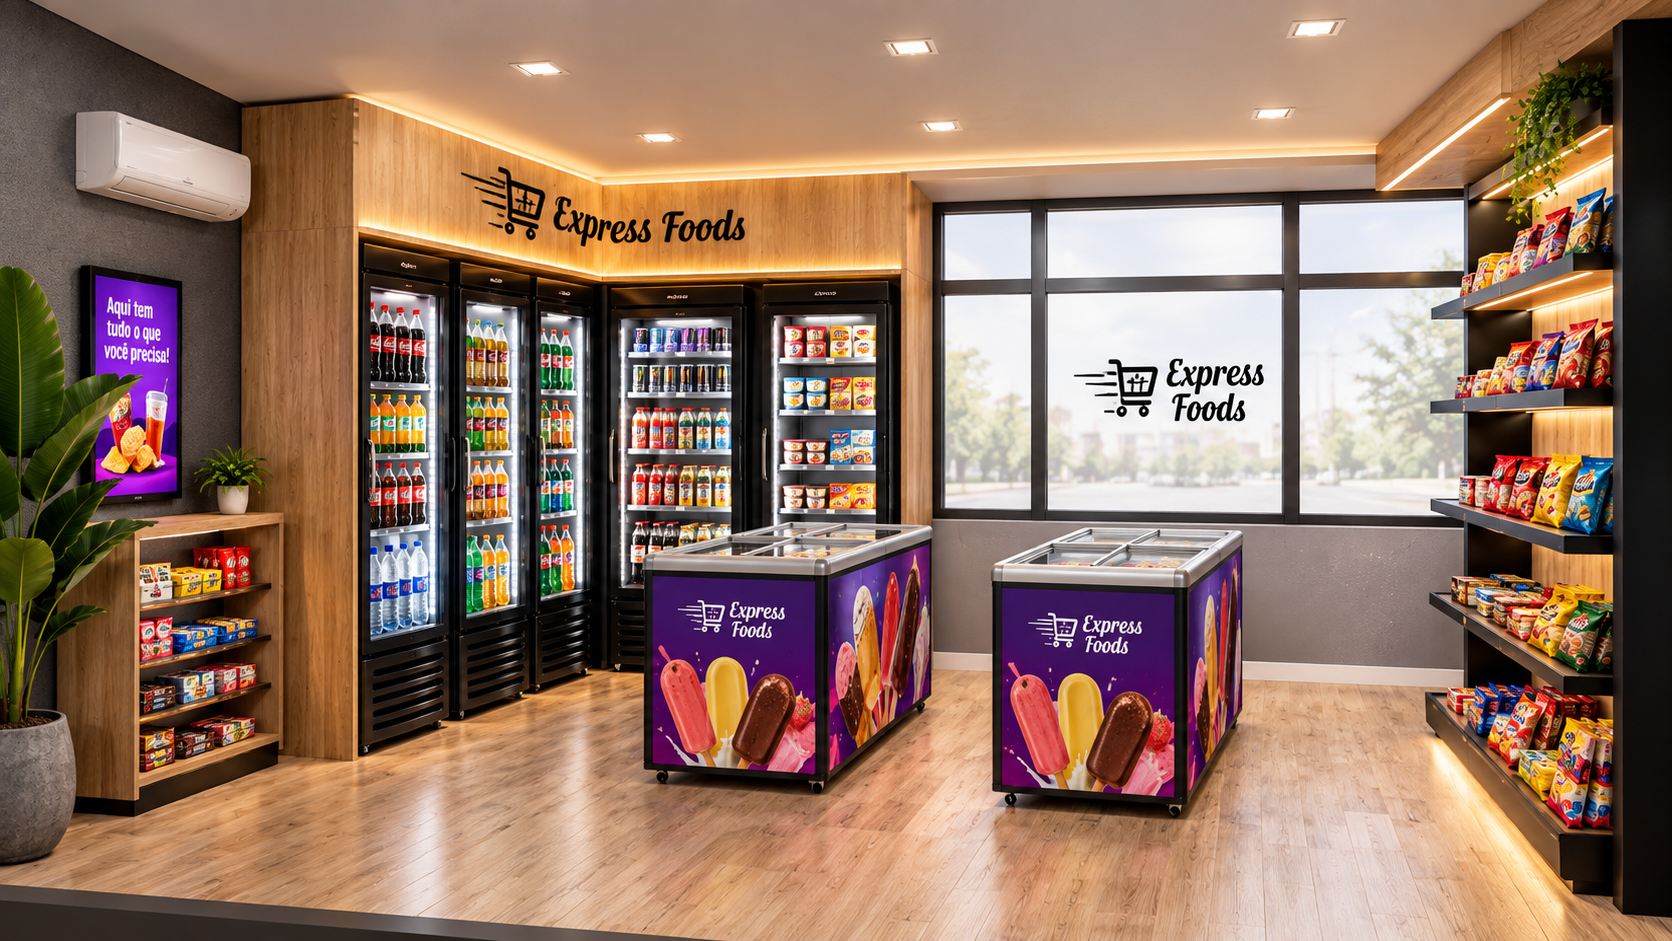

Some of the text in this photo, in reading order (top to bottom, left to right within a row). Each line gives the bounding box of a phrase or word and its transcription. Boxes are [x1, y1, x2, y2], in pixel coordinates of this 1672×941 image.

[553, 196, 745, 246] Express Foods
[107, 296, 153, 319] Aqui tem
[107, 320, 161, 345] tudo o que
[130, 346, 170, 365] precisa!
[1166, 358, 1264, 394] Express
[1171, 393, 1246, 422] Foods
[729, 602, 785, 622] Express
[732, 621, 772, 638] Foods
[1082, 615, 1142, 637] Express
[1086, 636, 1128, 654] Foods
